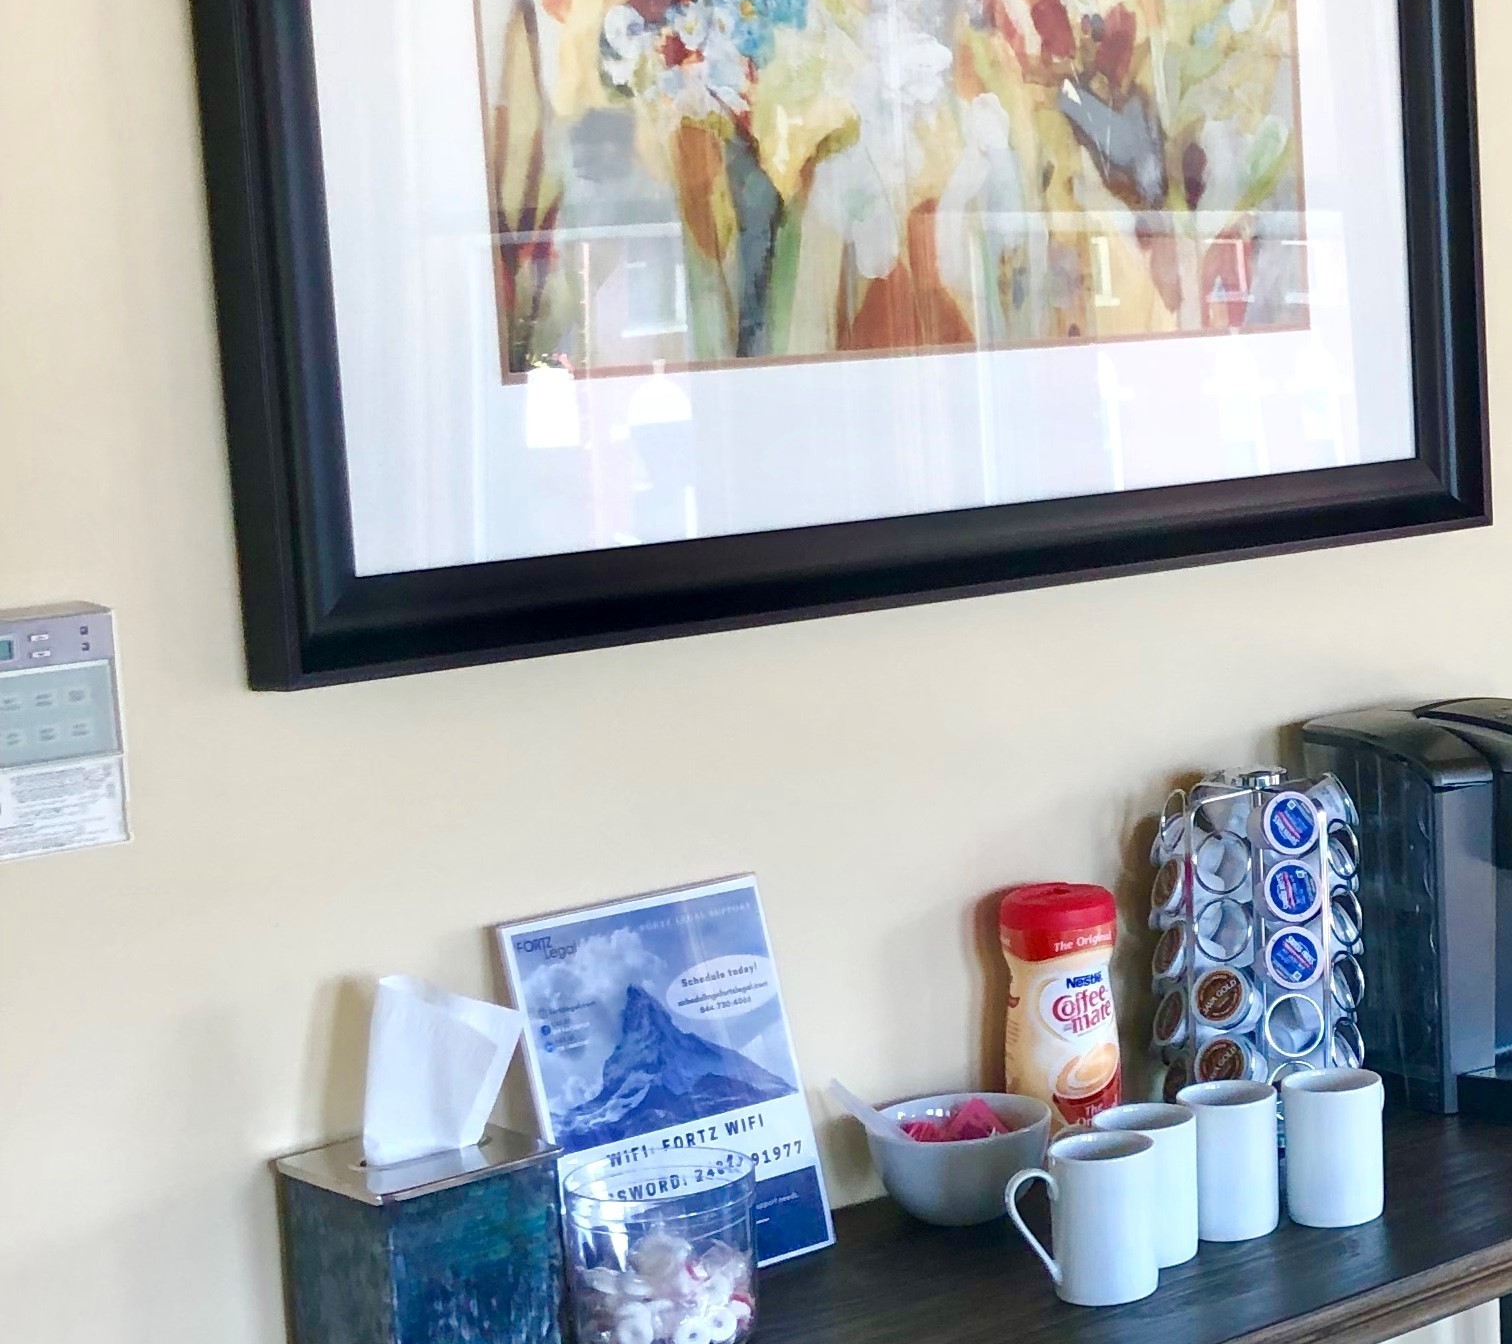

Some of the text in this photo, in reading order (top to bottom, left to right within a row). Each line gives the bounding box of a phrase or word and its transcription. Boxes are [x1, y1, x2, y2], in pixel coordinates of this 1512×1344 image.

[516, 936, 552, 954] FORTZ
[1054, 932, 1112, 953] The Original
[681, 971, 725, 987] Schedule
[1216, 979, 1237, 999] GOLD
[1072, 1001, 1112, 1033] mate
[662, 1126, 718, 1152] FORTZ
[725, 1113, 764, 1136] WIFI
